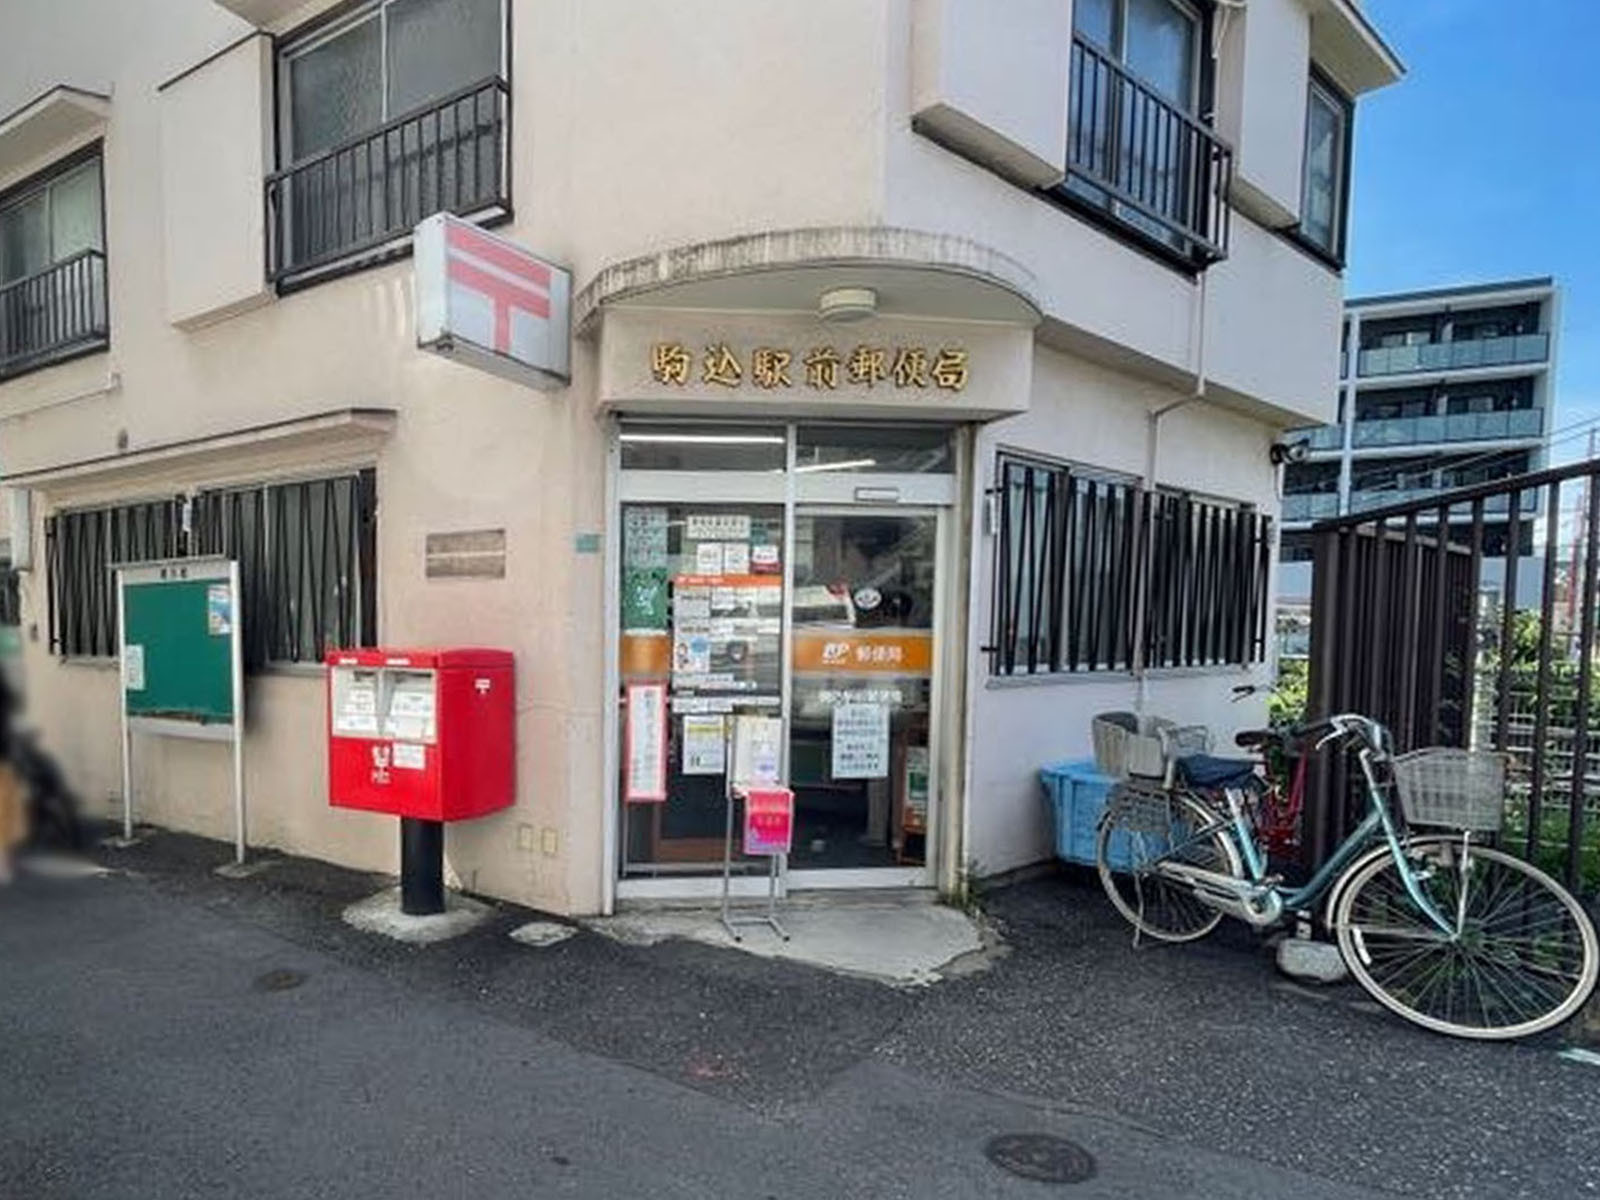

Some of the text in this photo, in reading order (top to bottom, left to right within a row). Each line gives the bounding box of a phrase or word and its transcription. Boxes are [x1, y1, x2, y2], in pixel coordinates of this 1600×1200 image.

[652, 343, 969, 391] 駒込駅前郵便局
